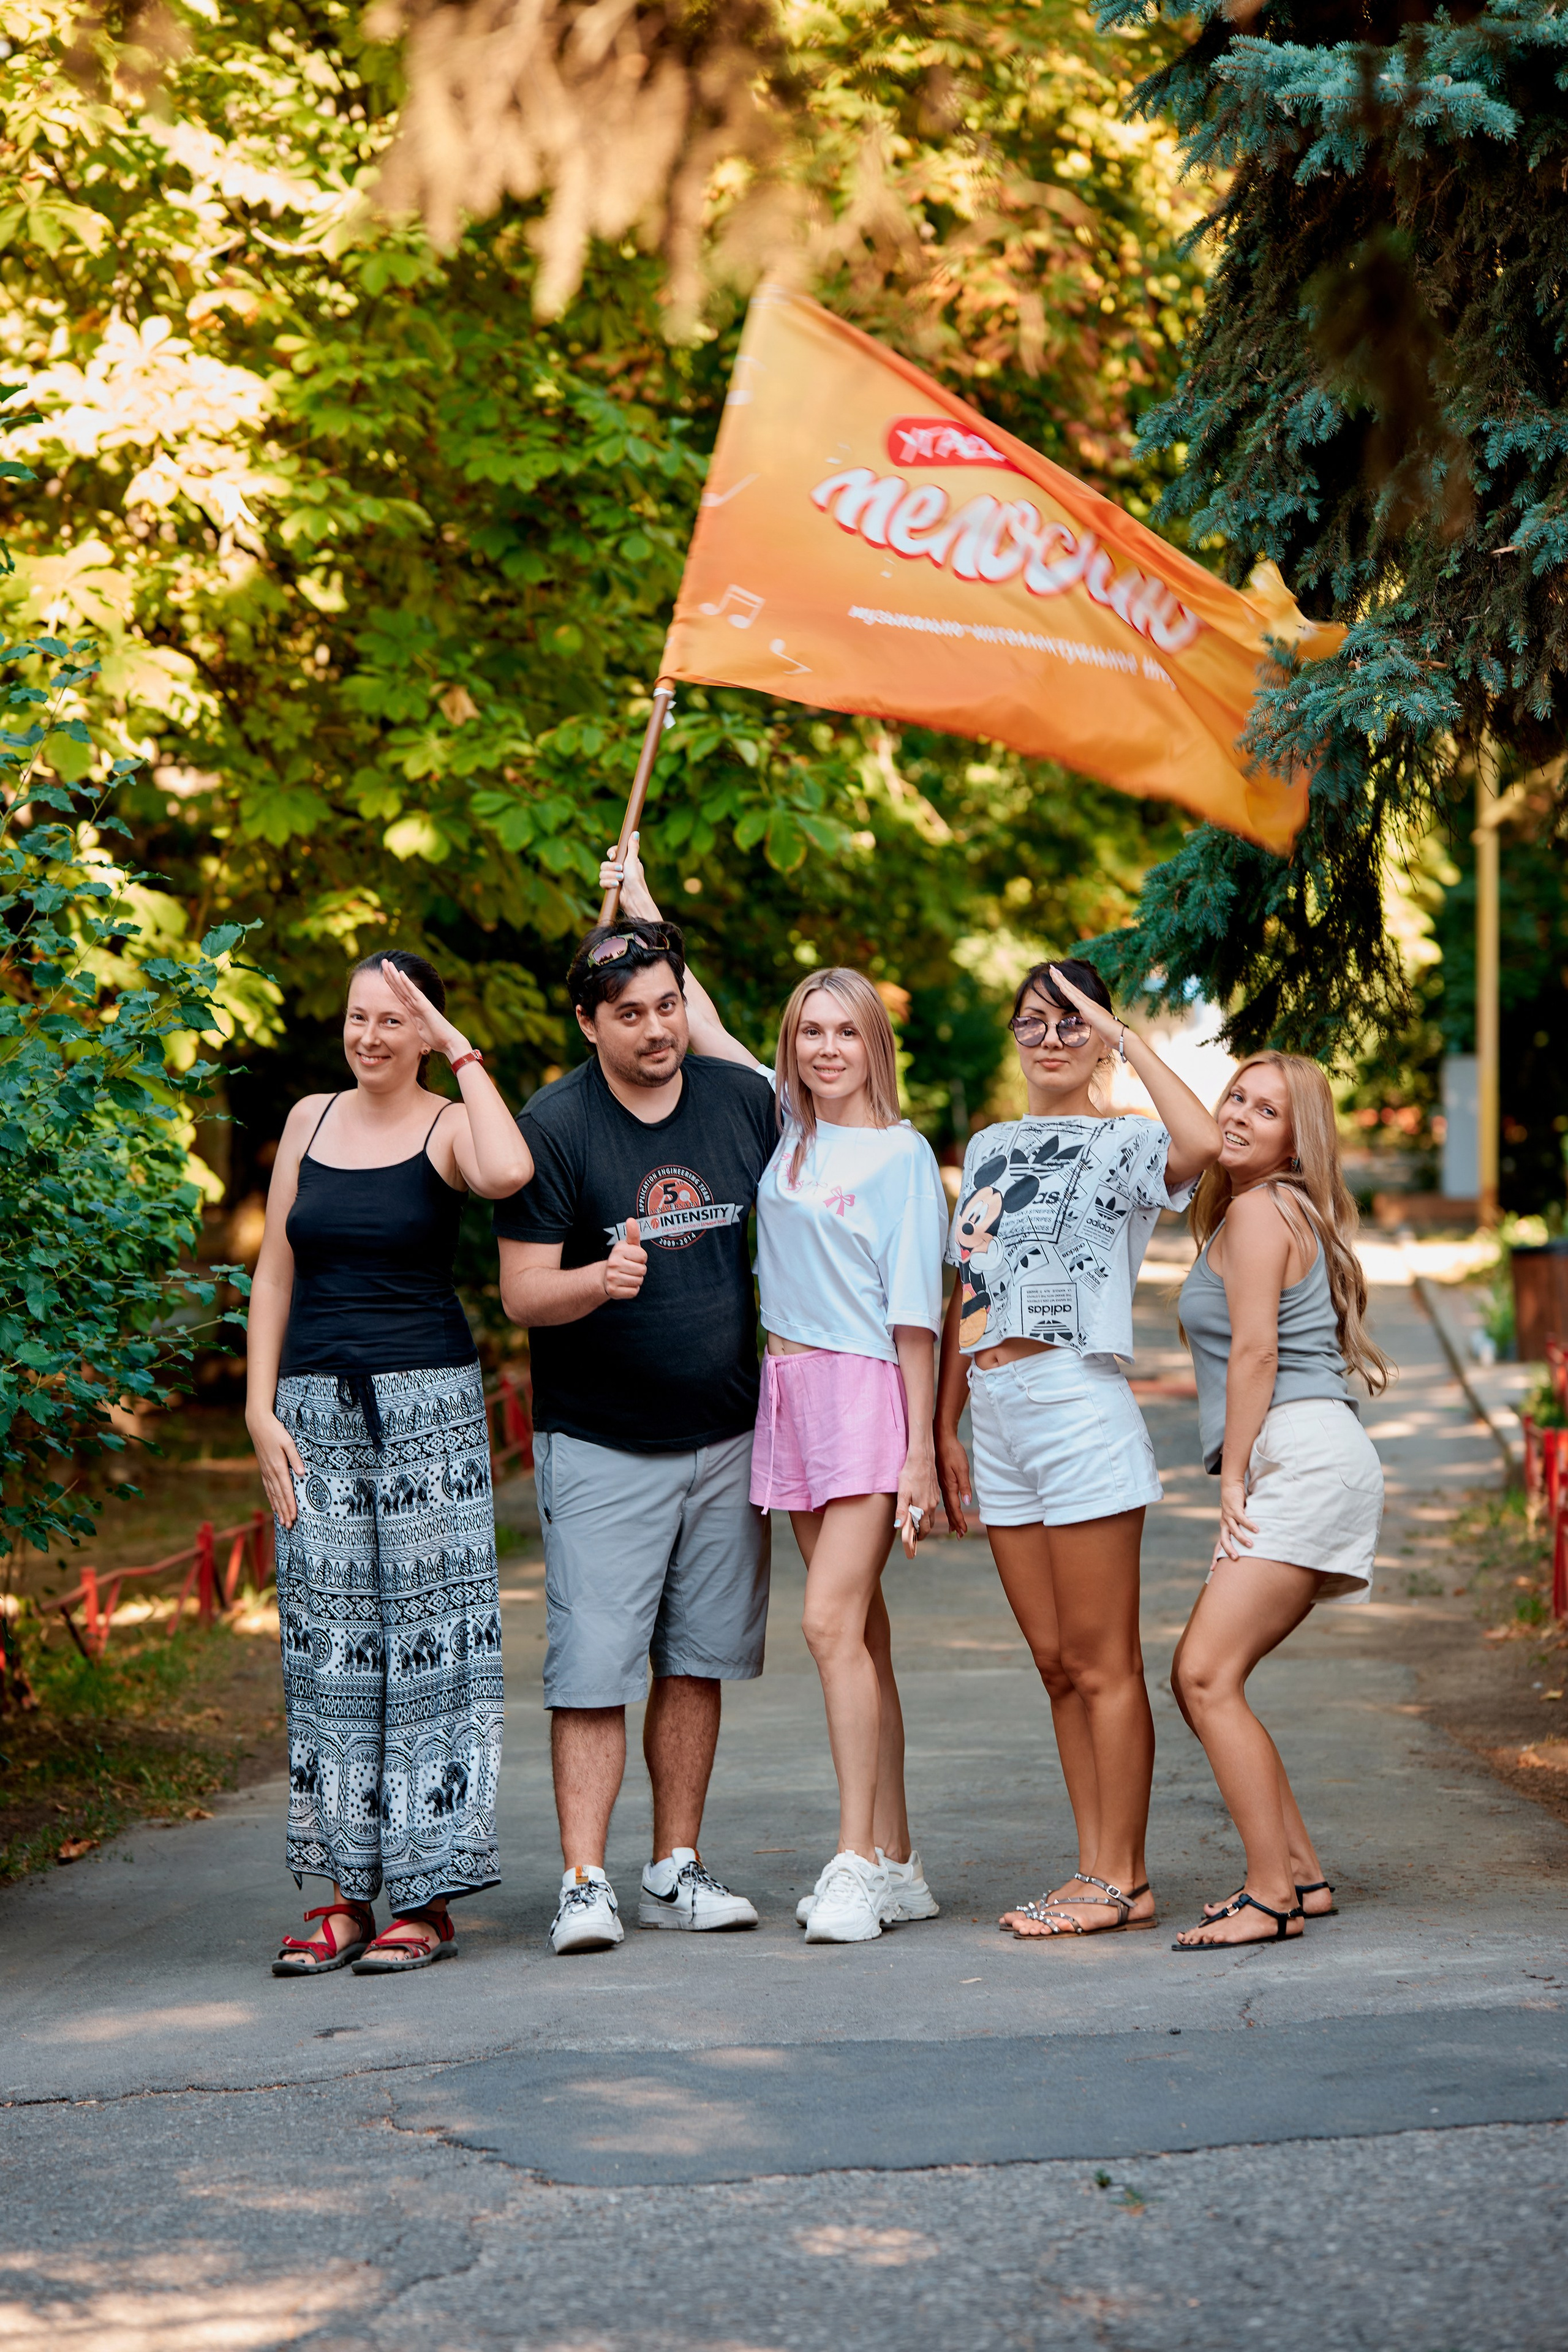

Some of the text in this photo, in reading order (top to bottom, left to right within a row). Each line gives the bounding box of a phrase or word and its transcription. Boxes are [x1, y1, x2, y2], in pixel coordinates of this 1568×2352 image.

[639, 1167, 710, 1213] APPLICATION ENGINEERING TEAM
[650, 1200, 698, 1213] ANNIVERSARY
[660, 1207, 729, 1227] INTENSITY
[1087, 1218, 1115, 1235] adidas
[659, 1232, 696, 1247] 2009-2014
[1062, 1242, 1085, 1257] adidas
[1028, 1305, 1072, 1316] adidas
